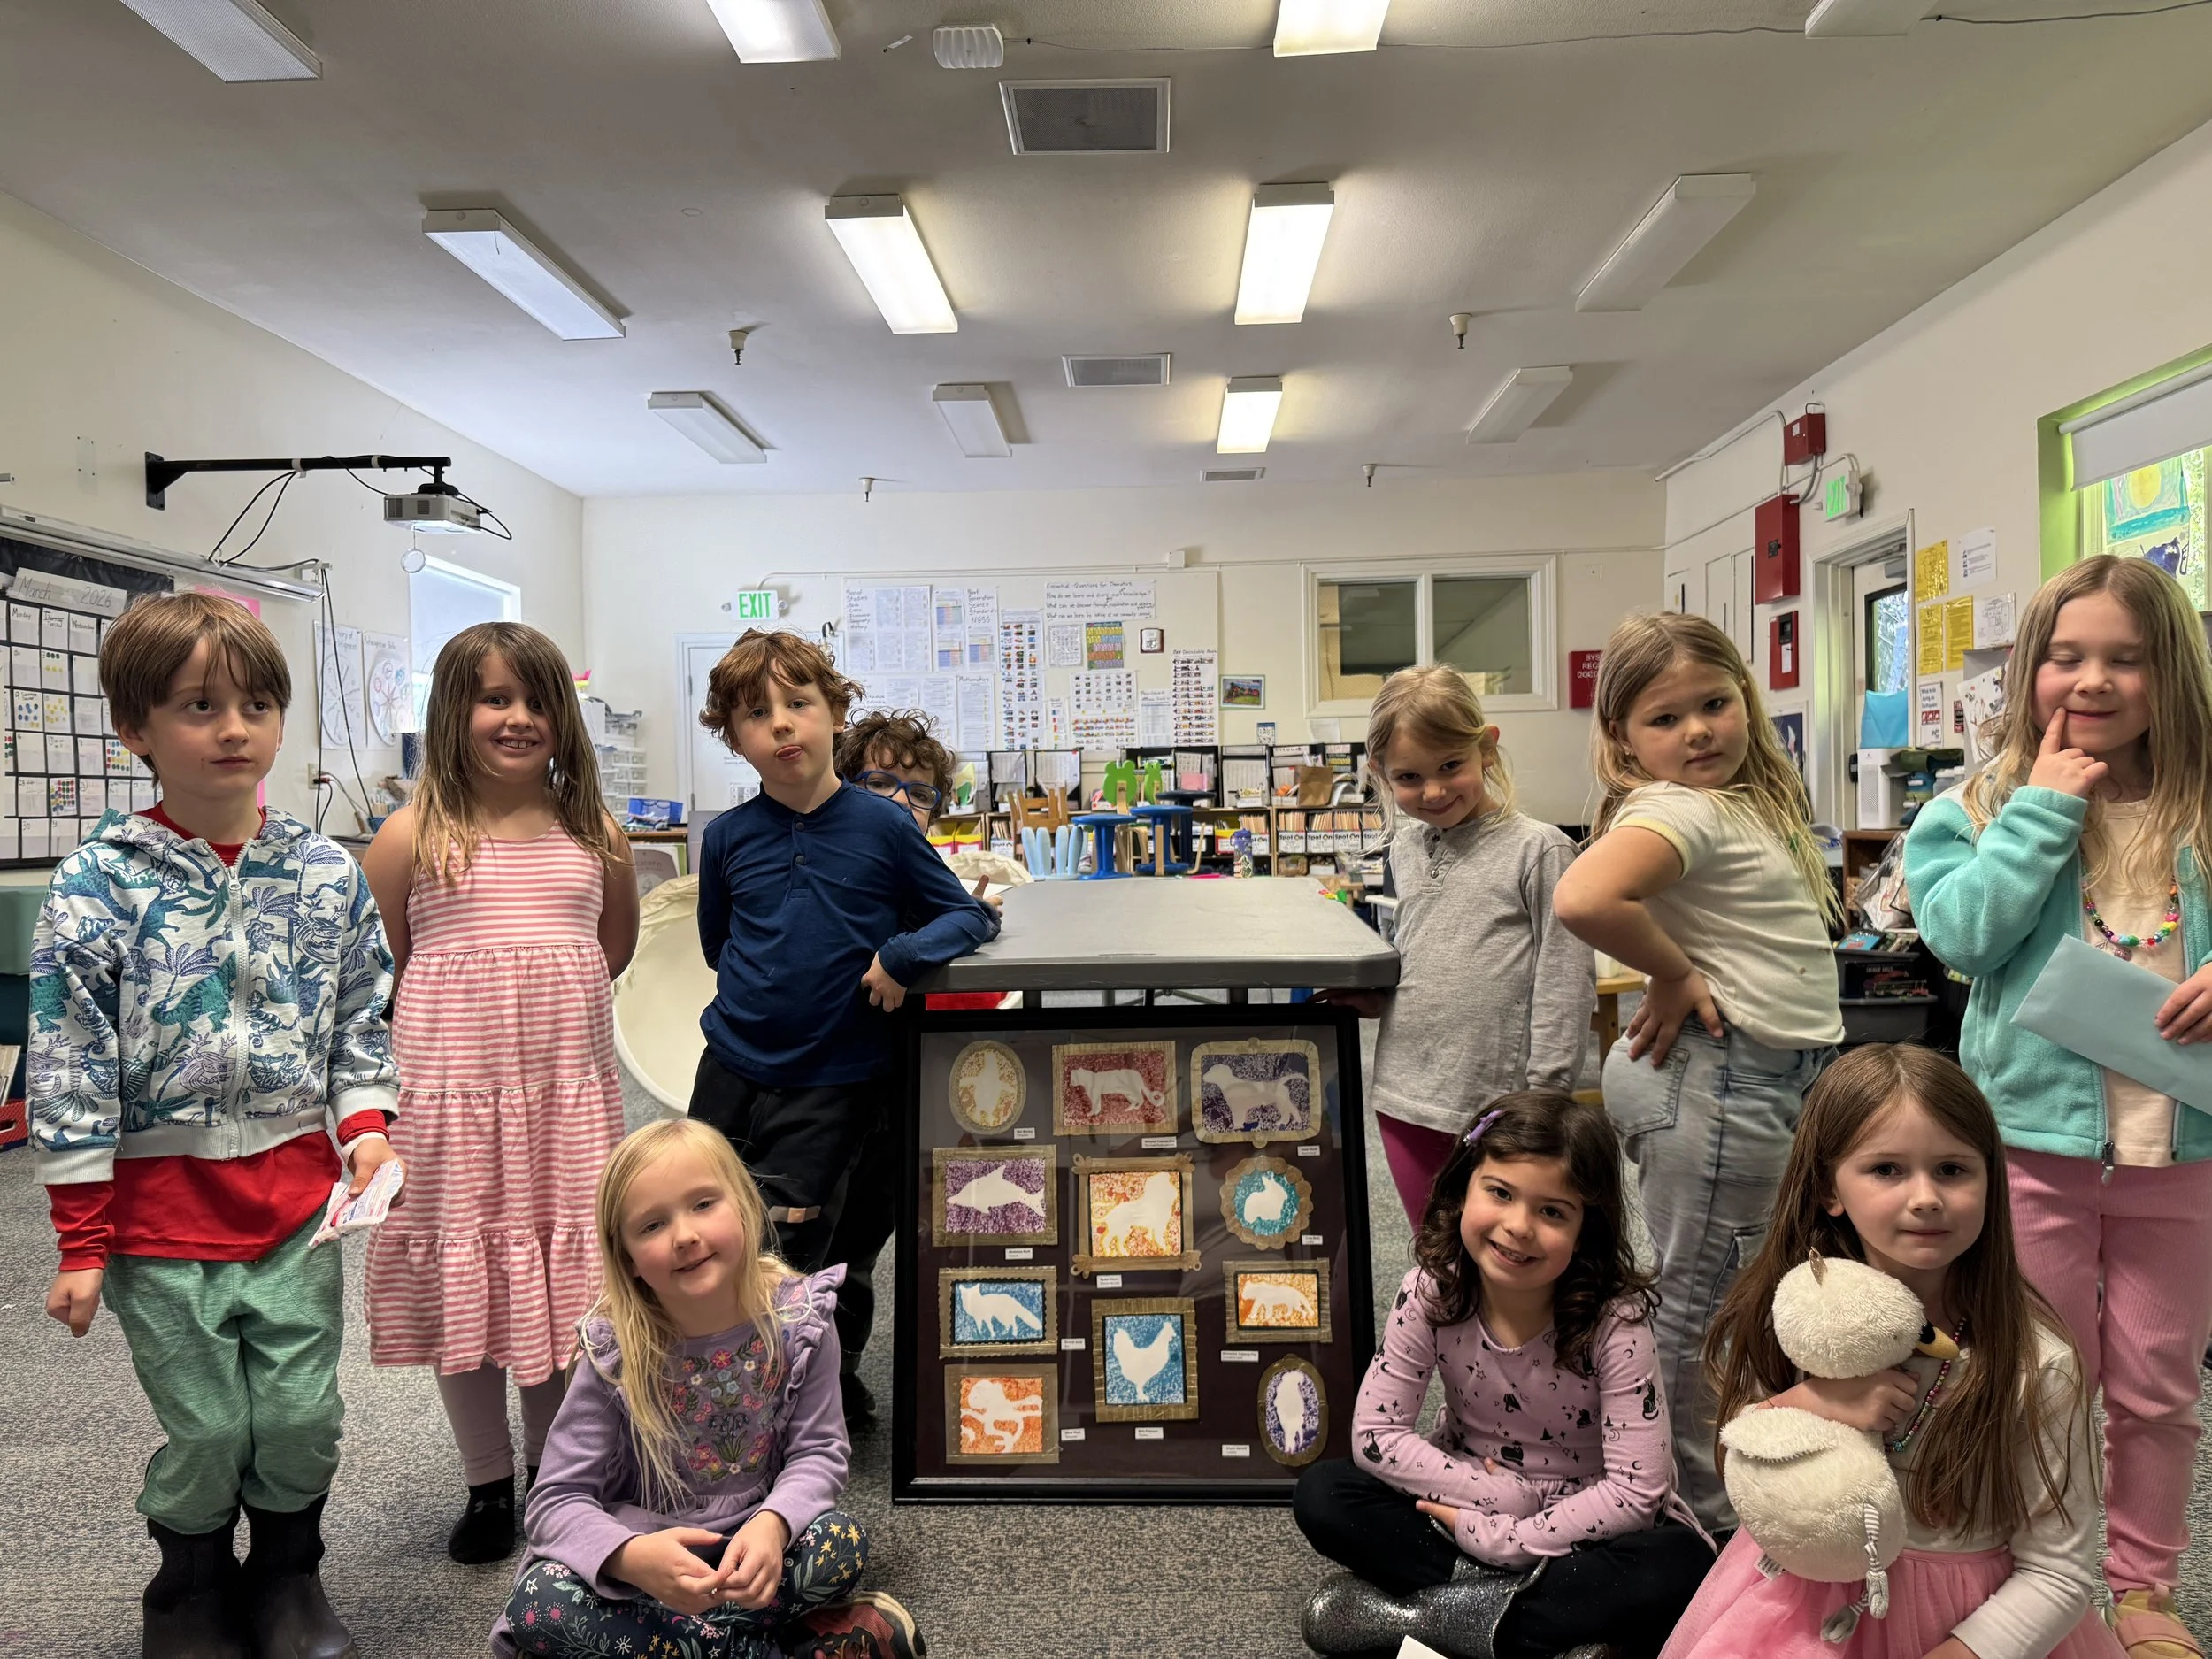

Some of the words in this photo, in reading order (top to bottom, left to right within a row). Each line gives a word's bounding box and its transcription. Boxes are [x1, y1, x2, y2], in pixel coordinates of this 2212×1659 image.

[1826, 475, 1846, 518] EXIT
[18, 575, 51, 601] March
[80, 585, 112, 608] 2026
[739, 593, 771, 618] EXIT
[12, 607, 32, 620] Monday
